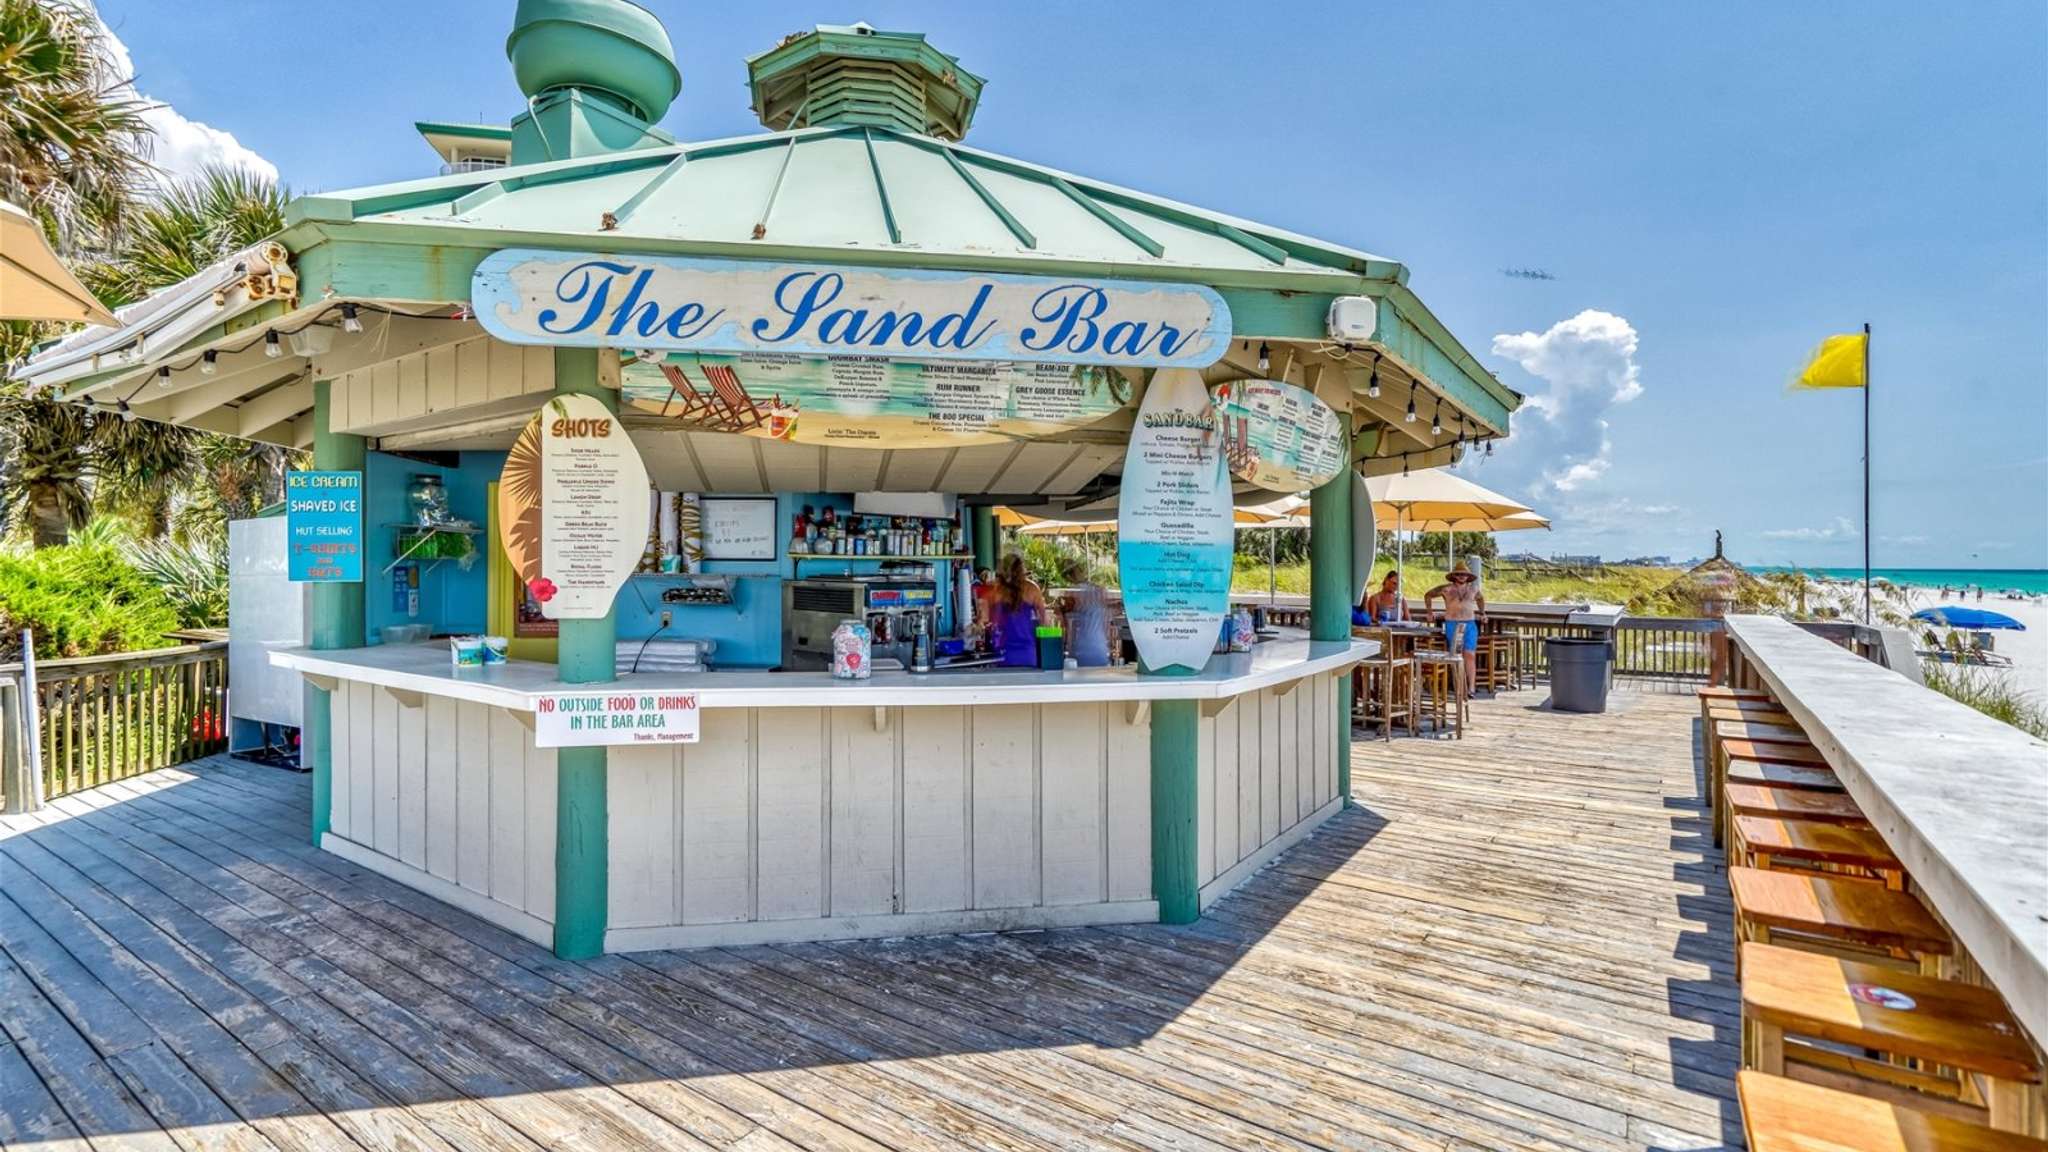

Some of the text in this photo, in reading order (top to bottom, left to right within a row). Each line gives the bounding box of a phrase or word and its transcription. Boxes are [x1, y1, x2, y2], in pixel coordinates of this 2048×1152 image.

[538, 261, 1199, 358] The Sand Bar
[936, 383, 981, 393] RUM RUNNER
[1015, 385, 1086, 396] GREY GOOSE ESSENCE
[928, 412, 941, 420] THE
[958, 413, 985, 422] SPECIAL
[1144, 412, 1214, 431] SANDBAR
[551, 417, 611, 438] SHOTS
[1180, 435, 1201, 443] Burger
[1188, 452, 1213, 461] Burgers
[289, 476, 358, 488] ICE CREAM
[291, 500, 357, 512] SHAVED ICE
[1160, 498, 1177, 506] Fajita
[295, 526, 353, 537] HUT SELLING
[539, 695, 696, 713] NO OUTSIDE FOOD OR DRINKS
[570, 714, 666, 730] IN THE BAR AREA
[634, 732, 694, 741] Thanks, Management
